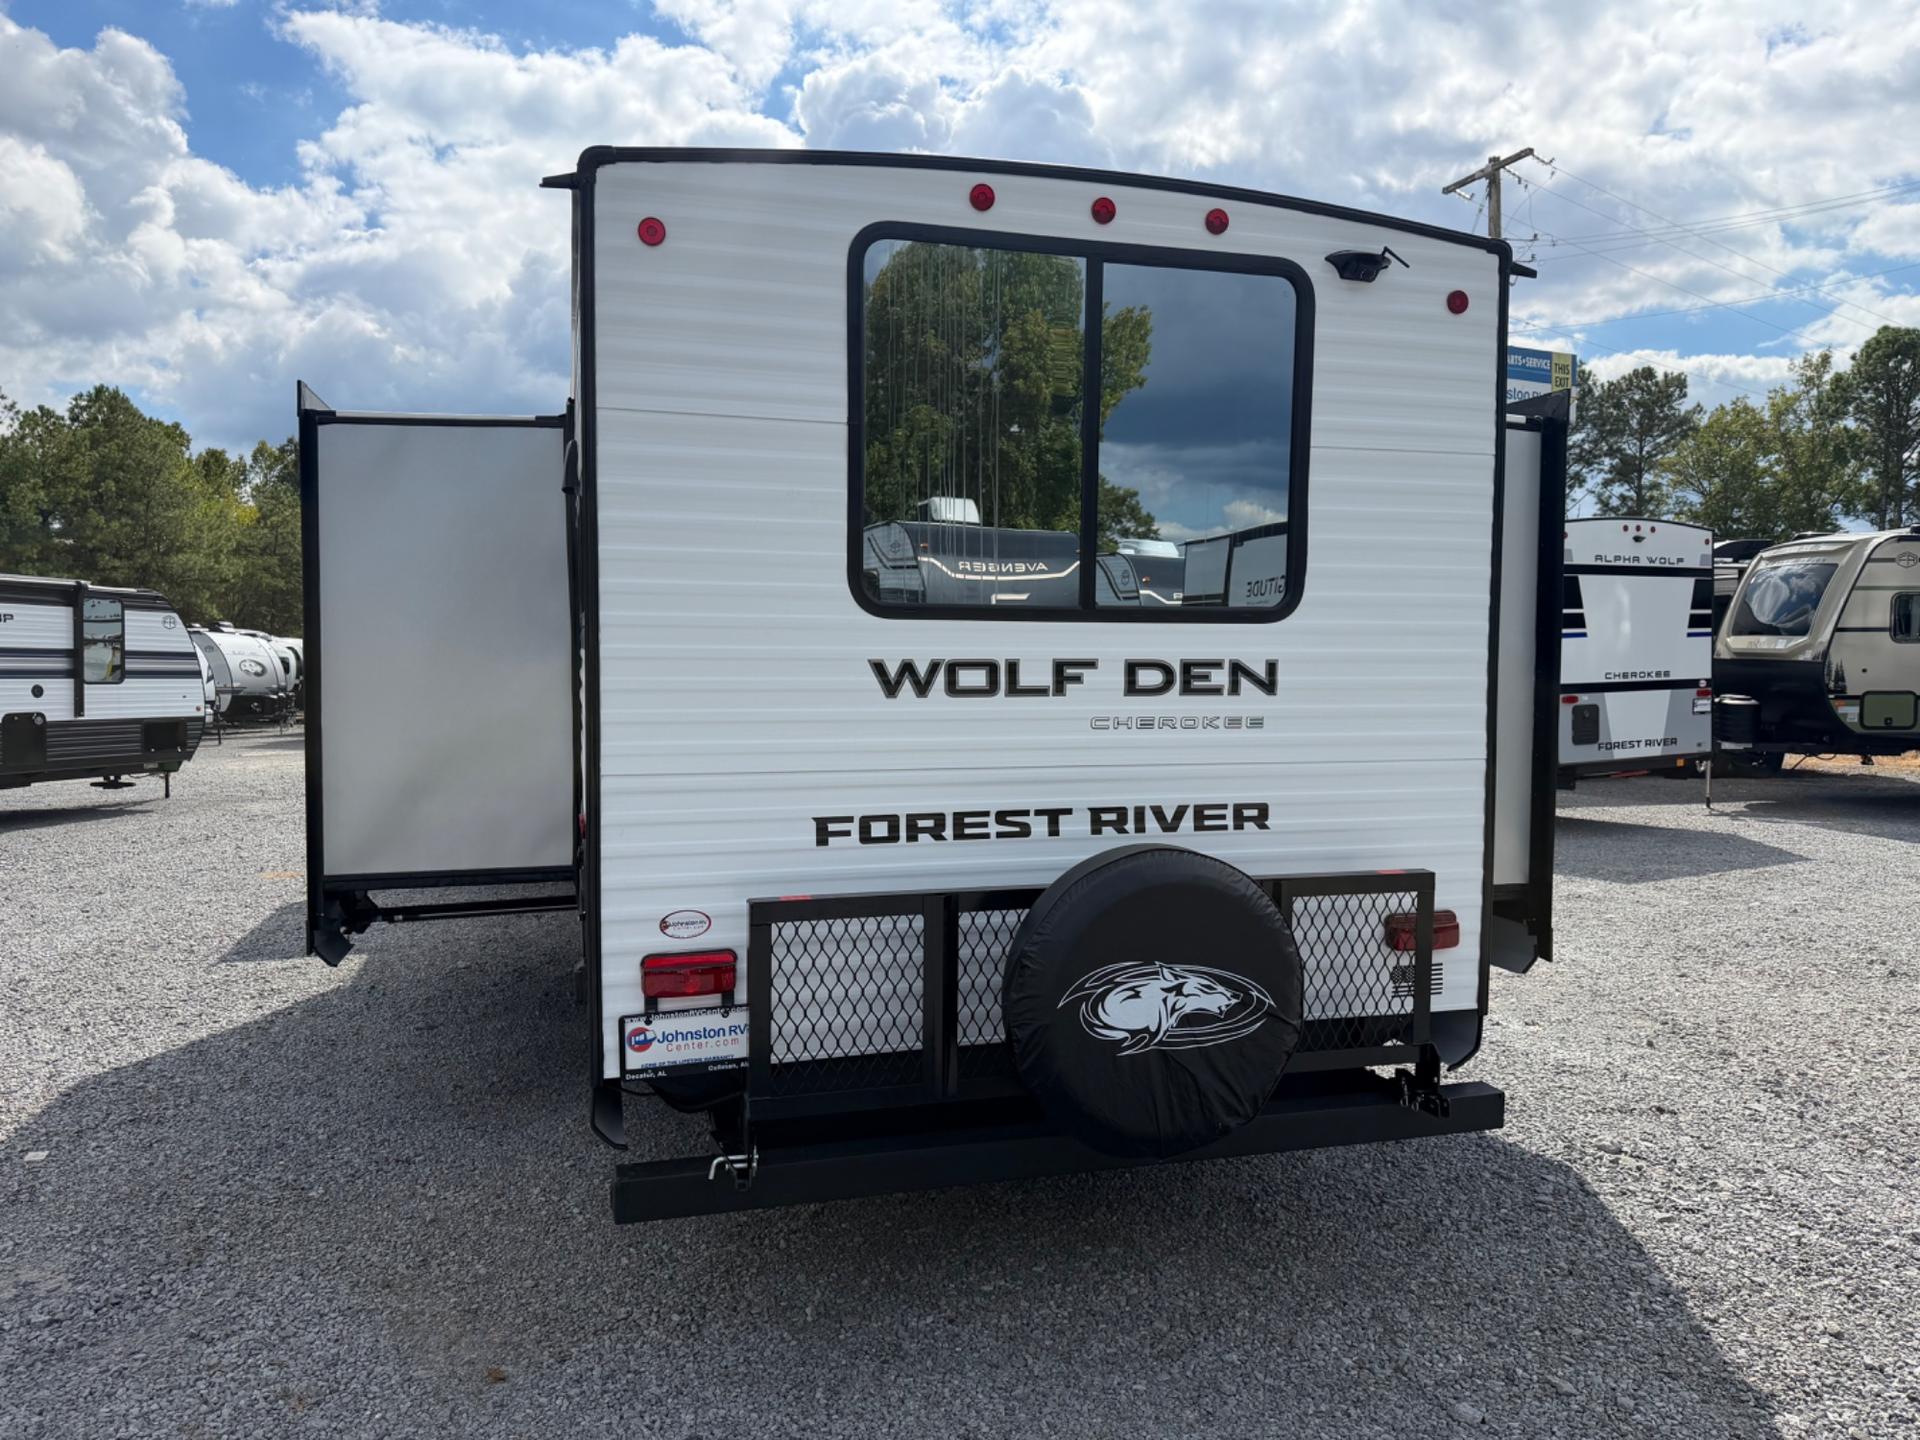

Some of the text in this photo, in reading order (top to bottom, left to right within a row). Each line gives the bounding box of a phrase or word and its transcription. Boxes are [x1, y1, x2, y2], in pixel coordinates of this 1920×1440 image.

[1554, 363, 1570, 376] THIS
[1554, 376, 1570, 388] EXIT
[1594, 554, 1685, 565] ALPHA WOLF
[868, 658, 1279, 699] WOLF DEN
[1605, 670, 1671, 680] CHEROKEE
[1090, 715, 1265, 730] CHEROKEE
[1597, 737, 1678, 752] FOREST RIVER
[812, 802, 1271, 847] FOREST RIVER
[657, 1023, 747, 1044] Johnston RV
[666, 1037, 739, 1052] Center.com
